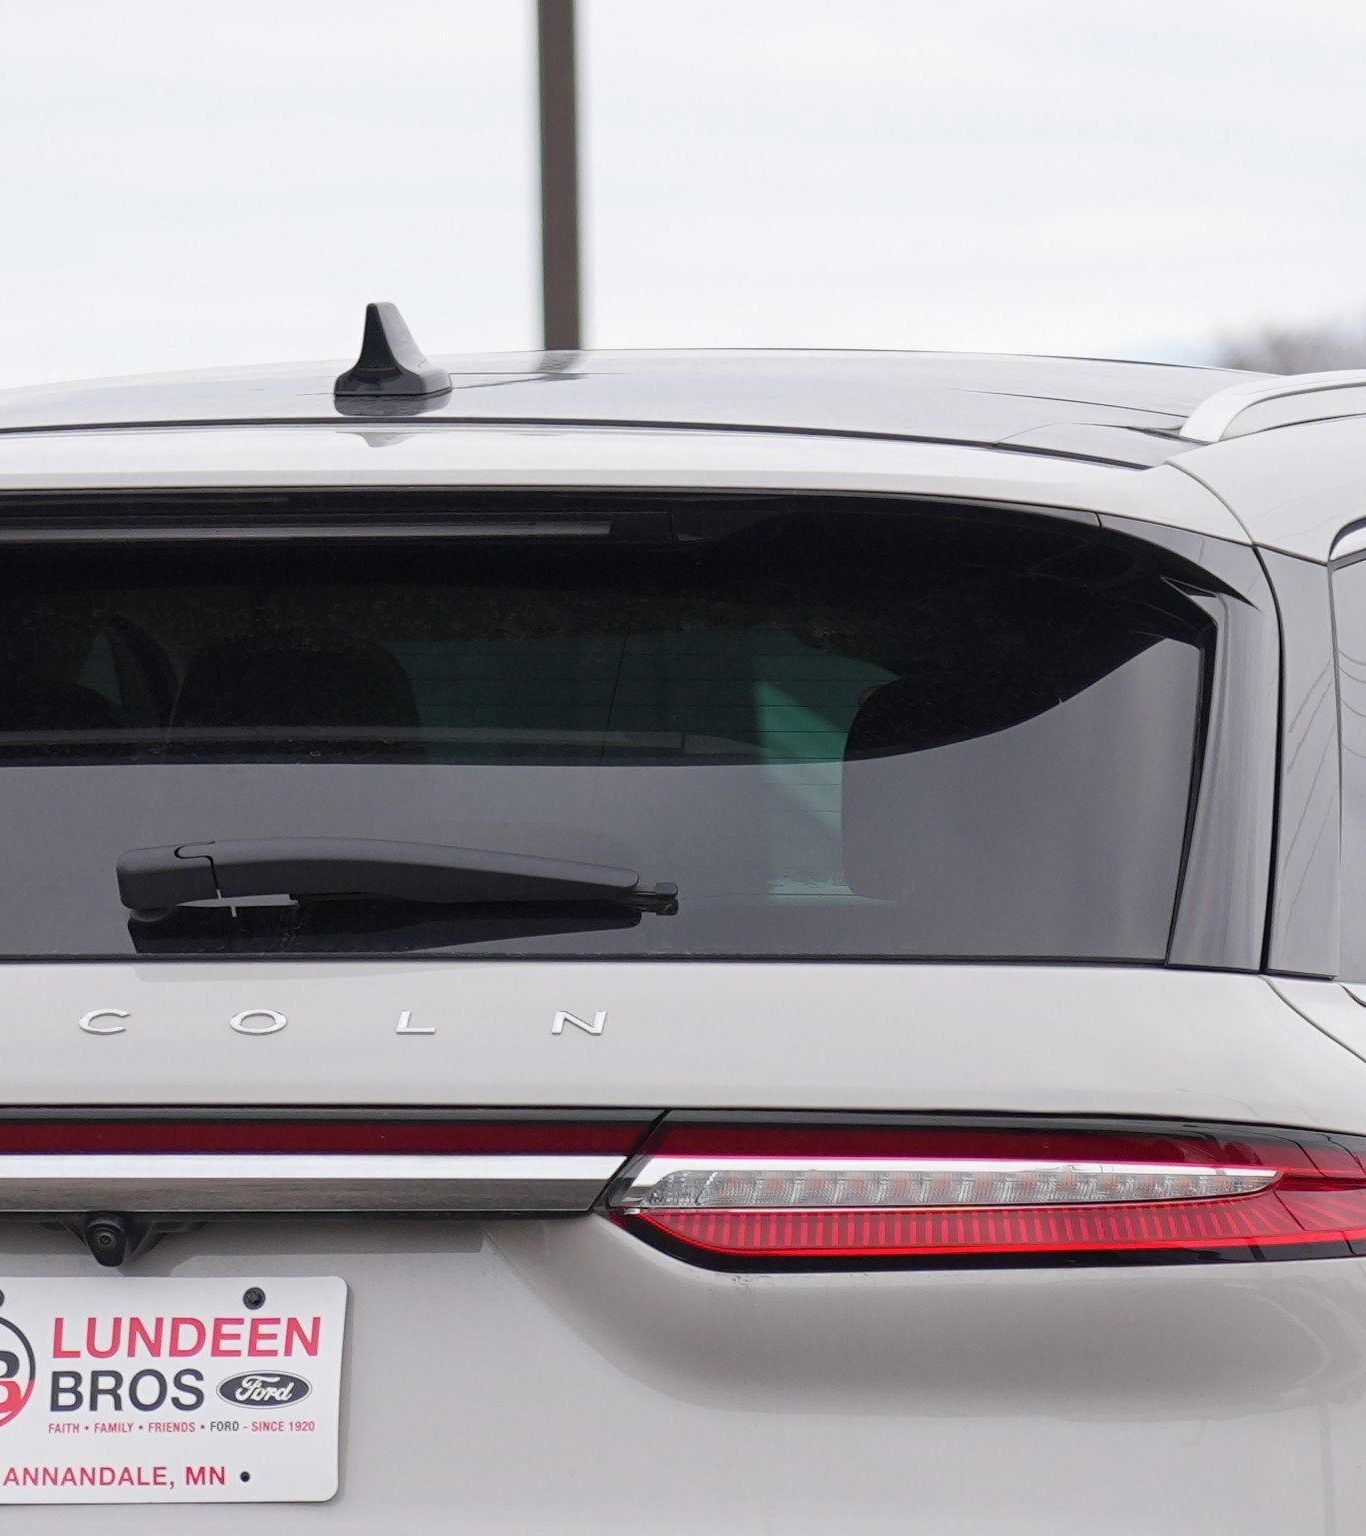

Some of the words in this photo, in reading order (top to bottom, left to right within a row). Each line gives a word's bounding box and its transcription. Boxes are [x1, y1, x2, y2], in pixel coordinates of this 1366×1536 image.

[52, 1316, 322, 1359] LUNDEEN
[49, 1367, 206, 1412] BROS
[234, 1375, 295, 1402] Ford
[48, 1422, 80, 1434] FAITH
[94, 1422, 135, 1433] FAMILY
[148, 1421, 196, 1433] FRIENDS
[210, 1420, 240, 1432] FORD
[251, 1420, 285, 1432] SINCE
[289, 1420, 316, 1432] 1920
[2, 1466, 176, 1489] ANNANDALE,
[185, 1465, 226, 1486] MN
